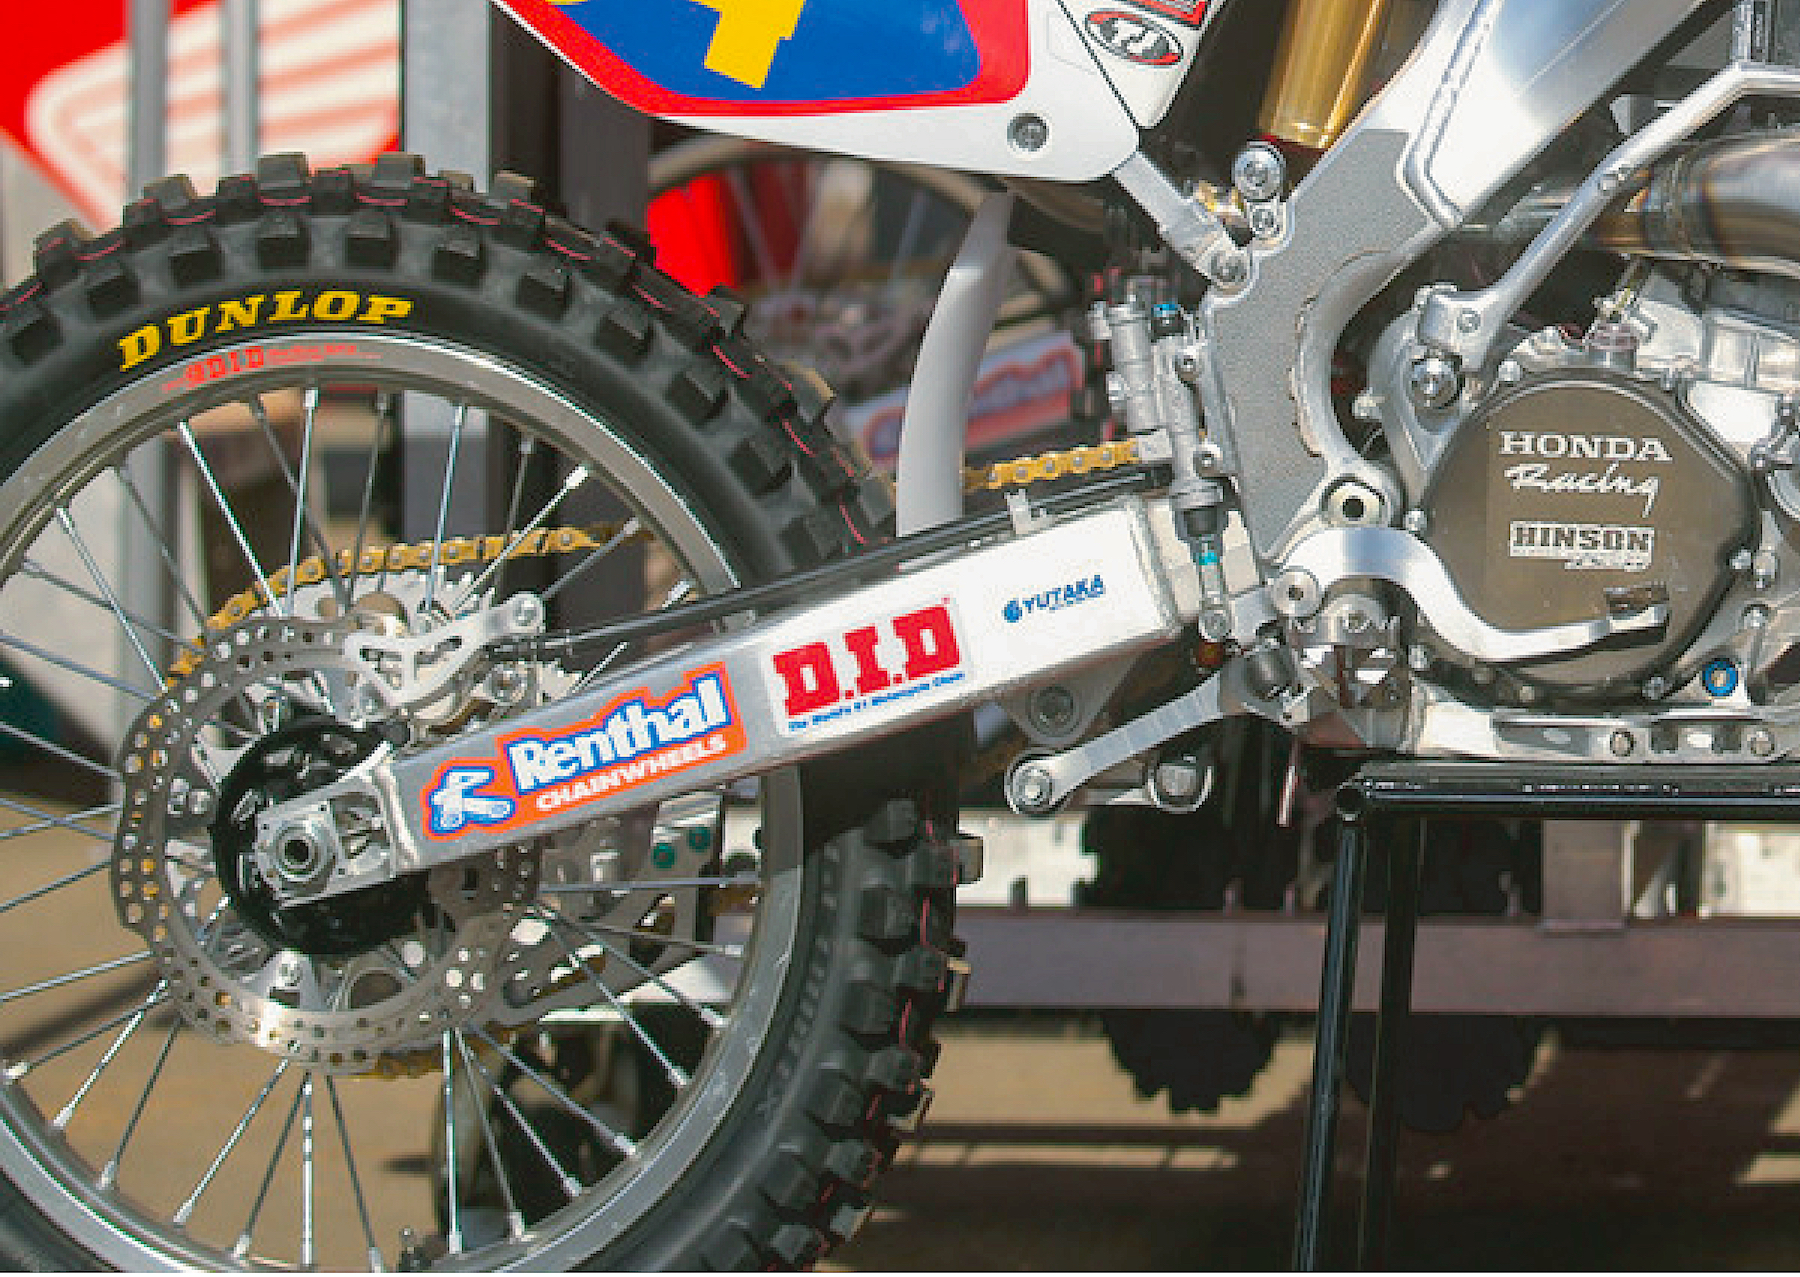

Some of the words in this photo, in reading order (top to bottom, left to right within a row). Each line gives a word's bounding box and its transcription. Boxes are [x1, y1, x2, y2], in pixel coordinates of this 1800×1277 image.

[117, 290, 415, 372] DUNLOP
[1498, 430, 1673, 462] HONDA
[1503, 461, 1660, 520] Racing
[1510, 525, 1654, 552] HINSON
[1021, 574, 1105, 614] YUTAKA
[772, 605, 961, 717] D.I.D
[507, 674, 731, 794] Renthal
[535, 732, 729, 811] CHAINWHEELS
